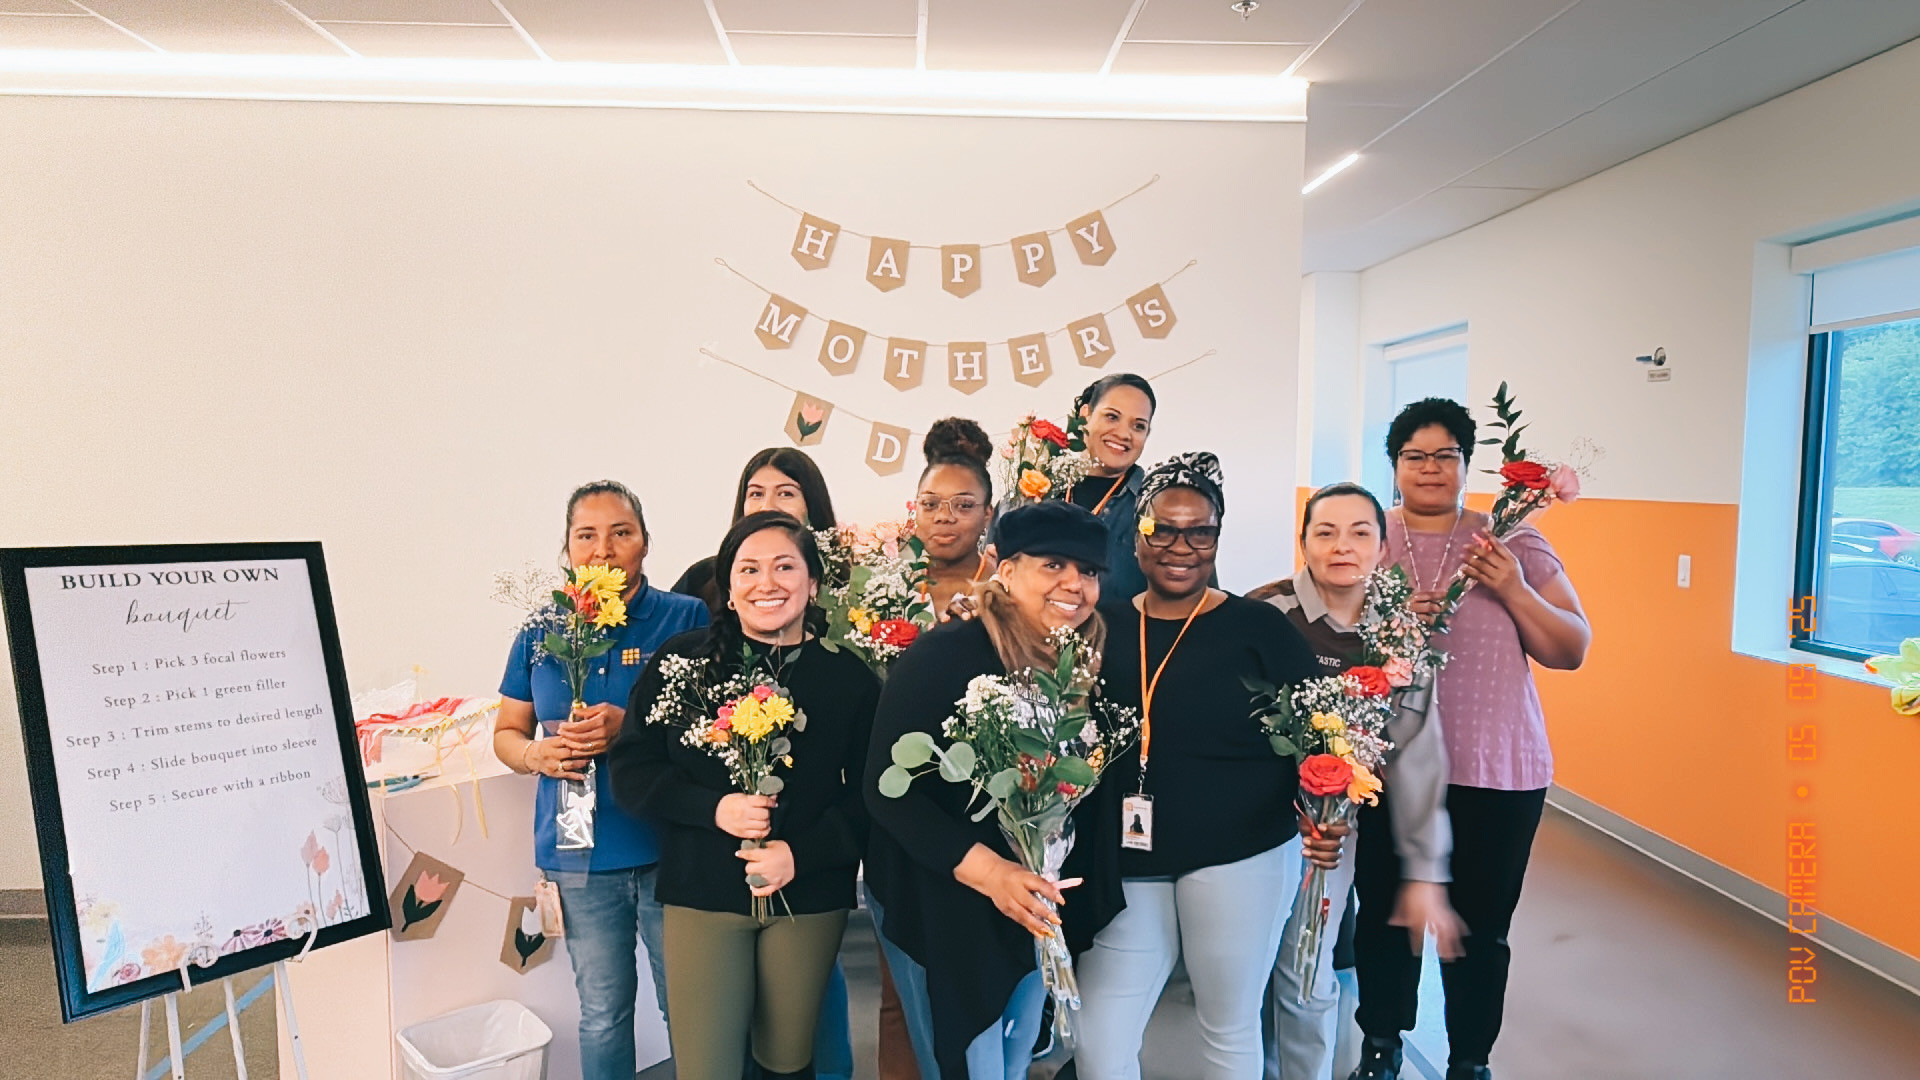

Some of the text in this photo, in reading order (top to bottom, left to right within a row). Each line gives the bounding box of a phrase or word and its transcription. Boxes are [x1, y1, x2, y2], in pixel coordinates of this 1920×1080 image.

[797, 221, 1104, 283] HAPPY
[758, 298, 1167, 383] MOTHER'S
[61, 567, 280, 590] BUILD YOUR OWN
[126, 599, 249, 633] bouquet
[92, 663, 125, 677] Step
[131, 661, 138, 671] 1
[155, 655, 185, 669] Pick
[191, 655, 199, 666] 3
[203, 651, 235, 665] focal
[240, 649, 287, 661] flowers
[104, 695, 136, 709] Step
[142, 693, 151, 704] 2
[166, 687, 197, 701] Pick
[203, 687, 208, 697] 1
[215, 683, 252, 699] green
[256, 678, 287, 691] filler
[66, 735, 101, 749] Step
[107, 731, 115, 742] 3
[131, 725, 169, 739] Trim
[174, 720, 213, 734] stems
[217, 717, 231, 728] to
[235, 708, 281, 725] desired
[285, 703, 323, 719] length
[87, 767, 121, 780] Step
[127, 762, 135, 773] 4
[151, 754, 186, 770] Slide
[191, 747, 247, 764] bouquet
[252, 744, 278, 755] into
[282, 738, 317, 751] sleeve
[109, 799, 142, 812] Step
[148, 793, 156, 805] 5
[171, 785, 218, 801] Secure
[223, 777, 254, 792] with
[259, 777, 265, 786] a
[270, 770, 311, 785] ribbon
